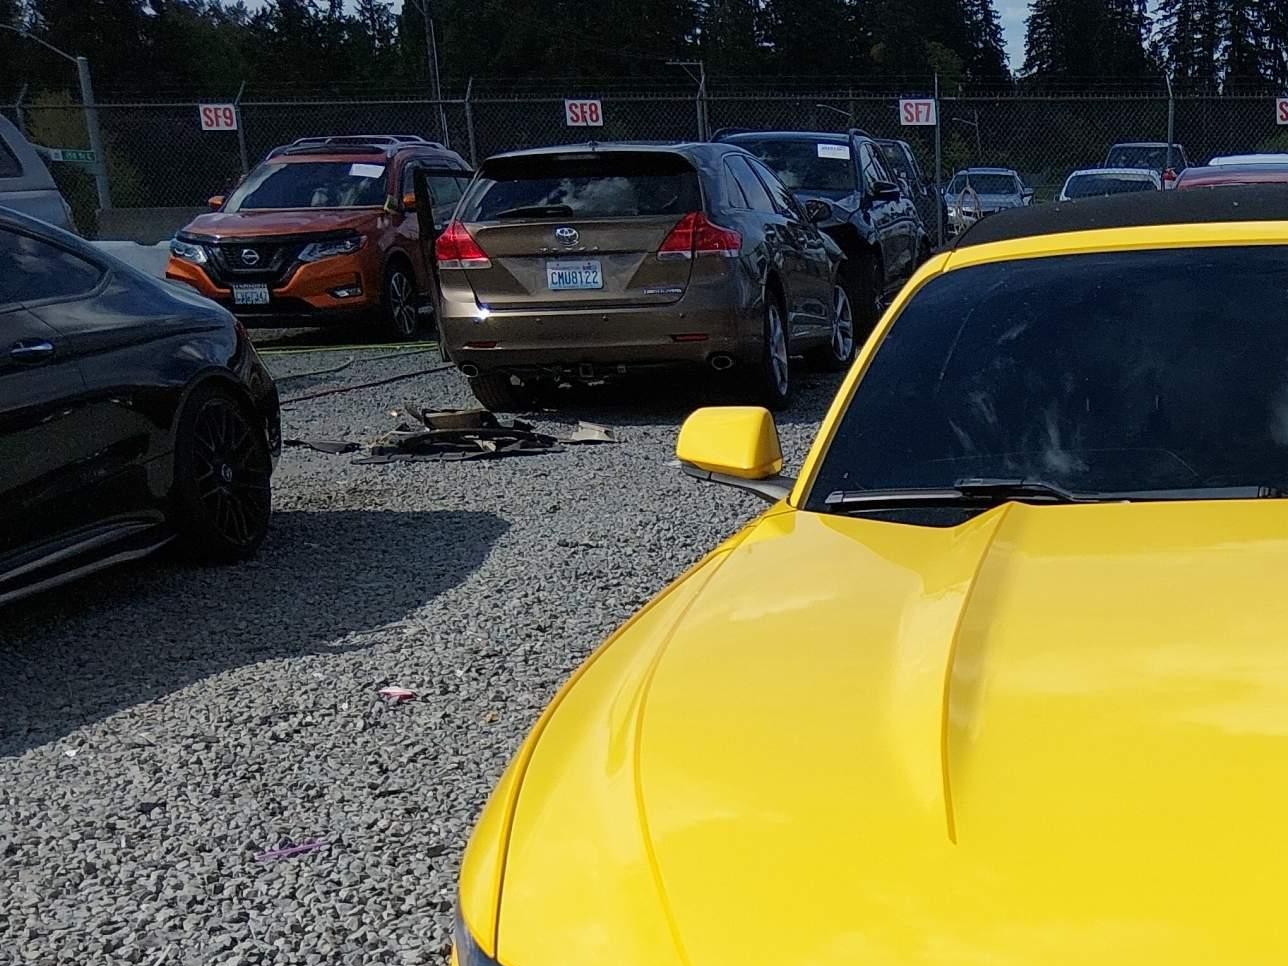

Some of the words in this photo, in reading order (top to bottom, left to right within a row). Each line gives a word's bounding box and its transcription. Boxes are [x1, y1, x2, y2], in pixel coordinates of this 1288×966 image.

[203, 107, 234, 127] SF9
[568, 102, 600, 123] SF8
[903, 102, 932, 122] SF7
[551, 271, 599, 286] CMU8122
